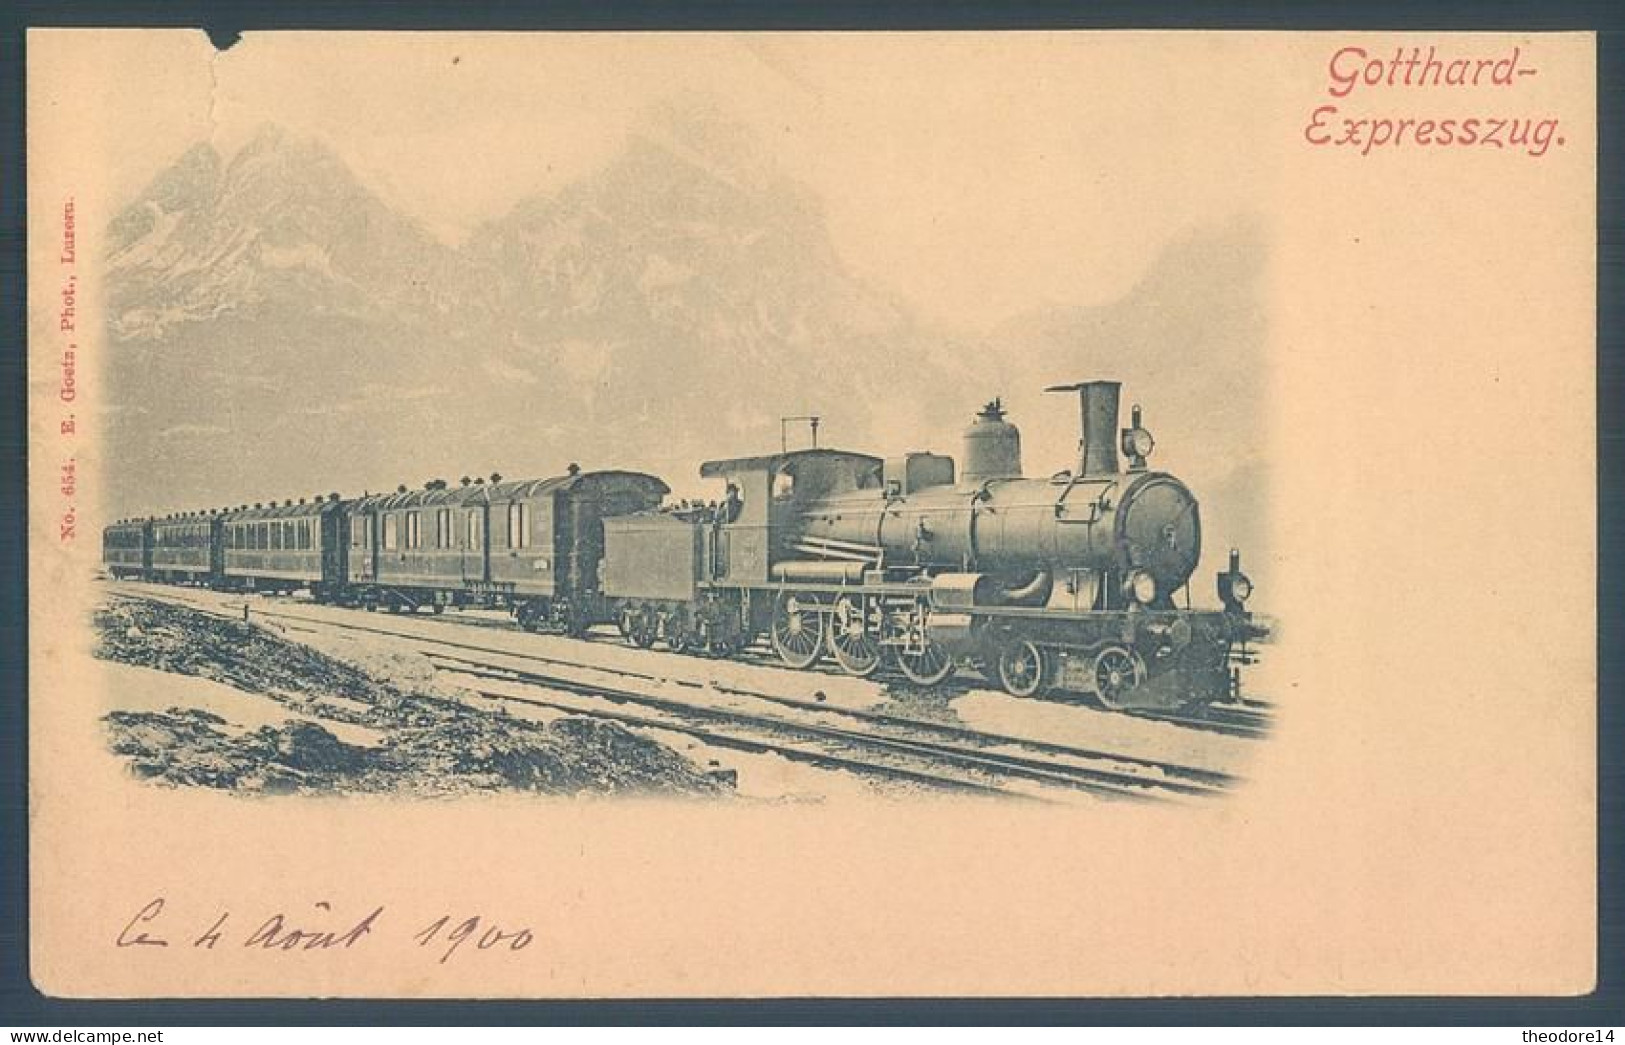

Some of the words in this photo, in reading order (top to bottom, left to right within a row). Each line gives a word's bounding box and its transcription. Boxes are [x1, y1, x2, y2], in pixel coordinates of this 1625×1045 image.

[1328, 46, 1538, 98] Gotthard-
[1305, 105, 1566, 156] Expresszug.
[60, 197, 75, 264] Luzern.
[60, 275, 77, 332] Phot.,
[60, 343, 77, 402] Goetz,
[60, 414, 75, 435] E.
[60, 458, 75, 496] 654.
[60, 507, 75, 541] No.
[194, 912, 230, 950] 4
[414, 914, 536, 964] 1900
